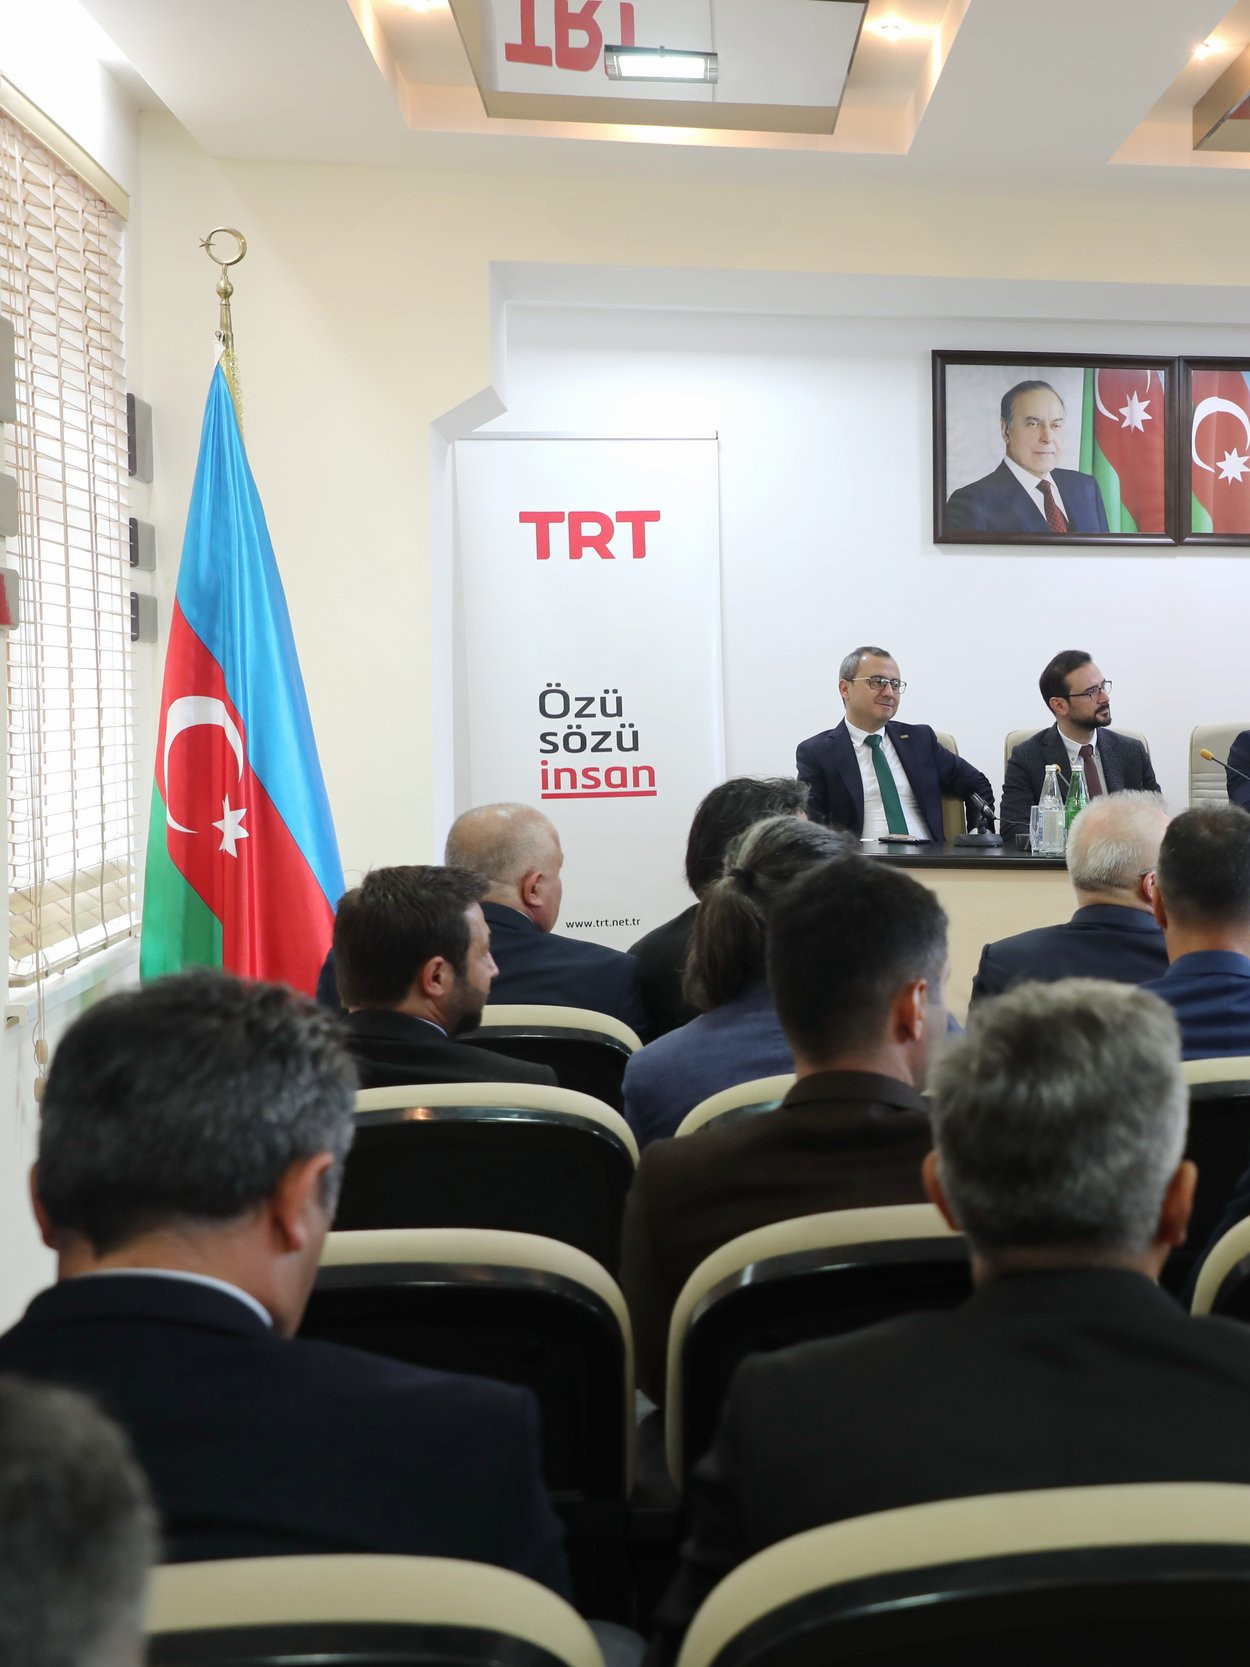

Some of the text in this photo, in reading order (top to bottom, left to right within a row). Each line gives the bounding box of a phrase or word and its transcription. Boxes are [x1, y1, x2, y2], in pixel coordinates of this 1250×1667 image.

[519, 511, 661, 560] TRT
[538, 682, 624, 719] Özü
[539, 722, 639, 754] sözü
[541, 760, 656, 789] insan
[565, 918, 641, 929] www.trt.net.tr
